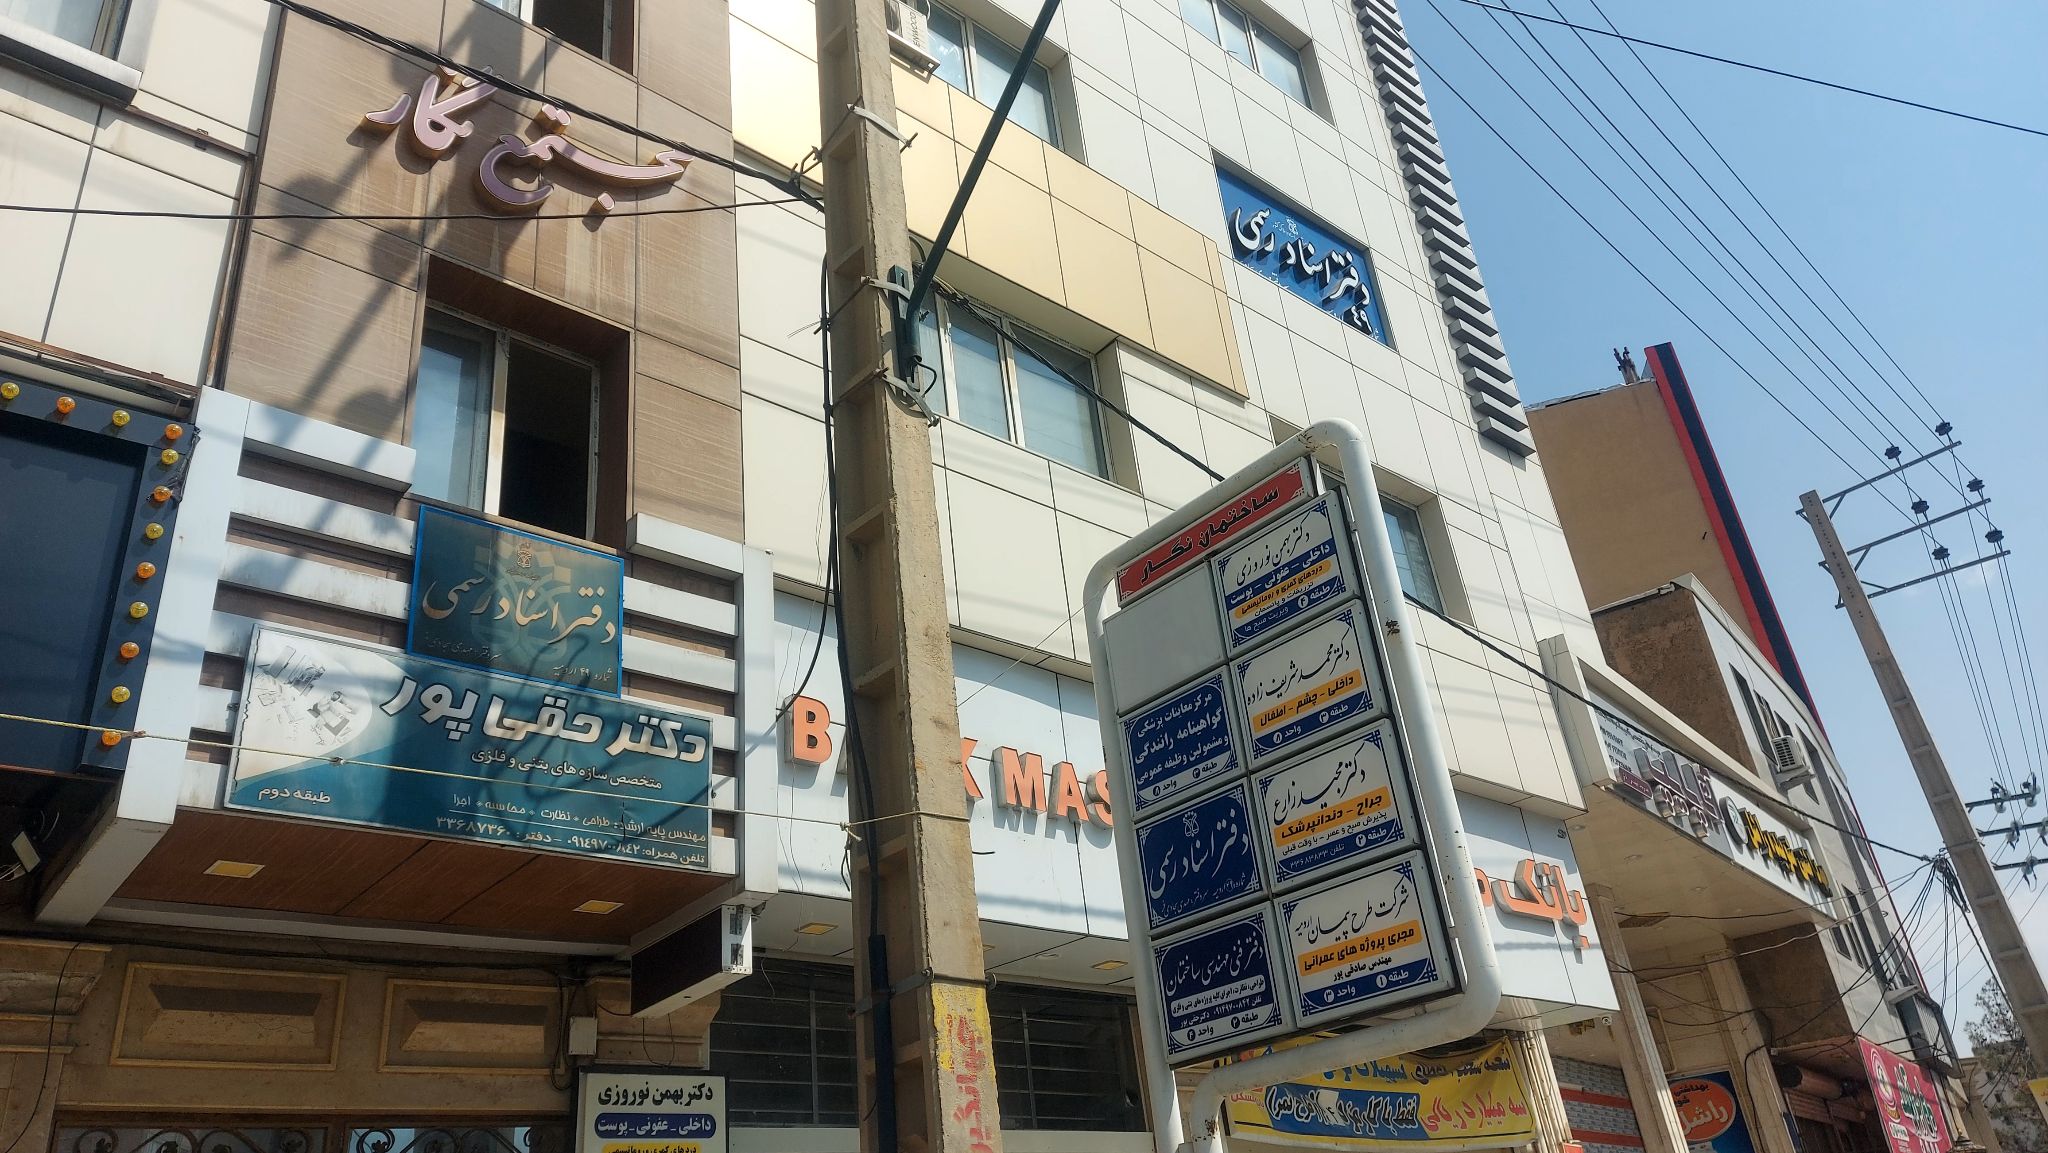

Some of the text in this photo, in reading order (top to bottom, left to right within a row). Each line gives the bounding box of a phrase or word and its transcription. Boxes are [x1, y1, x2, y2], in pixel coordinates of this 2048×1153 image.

[1235, 207, 1274, 250] رسمی
[1287, 238, 1330, 283] اسناد
[1330, 250, 1370, 305] دفتر
[1141, 487, 1280, 585] ساختمان نگار
[1237, 511, 1312, 586] دکتر بهمن نوروزی
[1230, 544, 1330, 604] داخلی عفونی پوست
[1309, 585, 1331, 600] طبقه
[422, 575, 616, 644] دفتر اسناد رسمی
[1298, 644, 1334, 683] محمد
[1330, 626, 1351, 675] دکتر
[1137, 692, 1213, 737] مرکز معاینات پزشکی
[1260, 675, 1354, 727] داخلی چشم اطفال
[1330, 704, 1348, 717] طبقه
[379, 676, 707, 763] دکتر حقی پور
[1284, 725, 1301, 738] واحد
[1135, 707, 1222, 764] گواهینامه رانندگی
[471, 749, 662, 790] متخصص سازه های بتنی و فلزی
[1137, 735, 1229, 784] و مشمولین وظیفه عمومی
[1201, 762, 1218, 773] طبقه
[258, 787, 331, 805] طبقه دوم
[1162, 780, 1177, 791] واحد
[1273, 742, 1366, 825] دکتر مجید زارع
[453, 793, 471, 806] اجرا
[1357, 795, 1382, 816] جراح
[540, 809, 571, 821] نظارت
[582, 814, 610, 827] طراحی
[1346, 821, 1361, 834] صبح
[669, 828, 706, 842] مهندس
[1298, 837, 1313, 848] وقت
[1326, 828, 1340, 841] عصر
[1368, 828, 1387, 841] طبقه
[680, 852, 705, 865] تلفن
[1150, 808, 1249, 899] دفتر اسناد رسمی
[1282, 844, 1296, 856] قبلی
[1374, 875, 1410, 920] شرکت
[1491, 858, 1591, 950] بانک
[1308, 909, 1351, 944] پیمان
[1351, 900, 1374, 934] طرح
[1304, 928, 1415, 971] مجری پروژه های عمرانی
[1166, 931, 1264, 997] دفتر فنی مهندسی ساختمان
[1333, 955, 1392, 982] مهندس صادقی پور
[1388, 969, 1409, 983] طبقه
[1337, 985, 1356, 997] واحد
[1198, 1025, 1214, 1036] واحد
[1241, 1012, 1258, 1025] طبقه
[598, 1081, 713, 1106] دکتر بهمن نوروزی
[1508, 1096, 1527, 1116] سه
[1392, 1095, 1419, 1128] فقط
[597, 1116, 711, 1136] داخلی عفونی پوست
